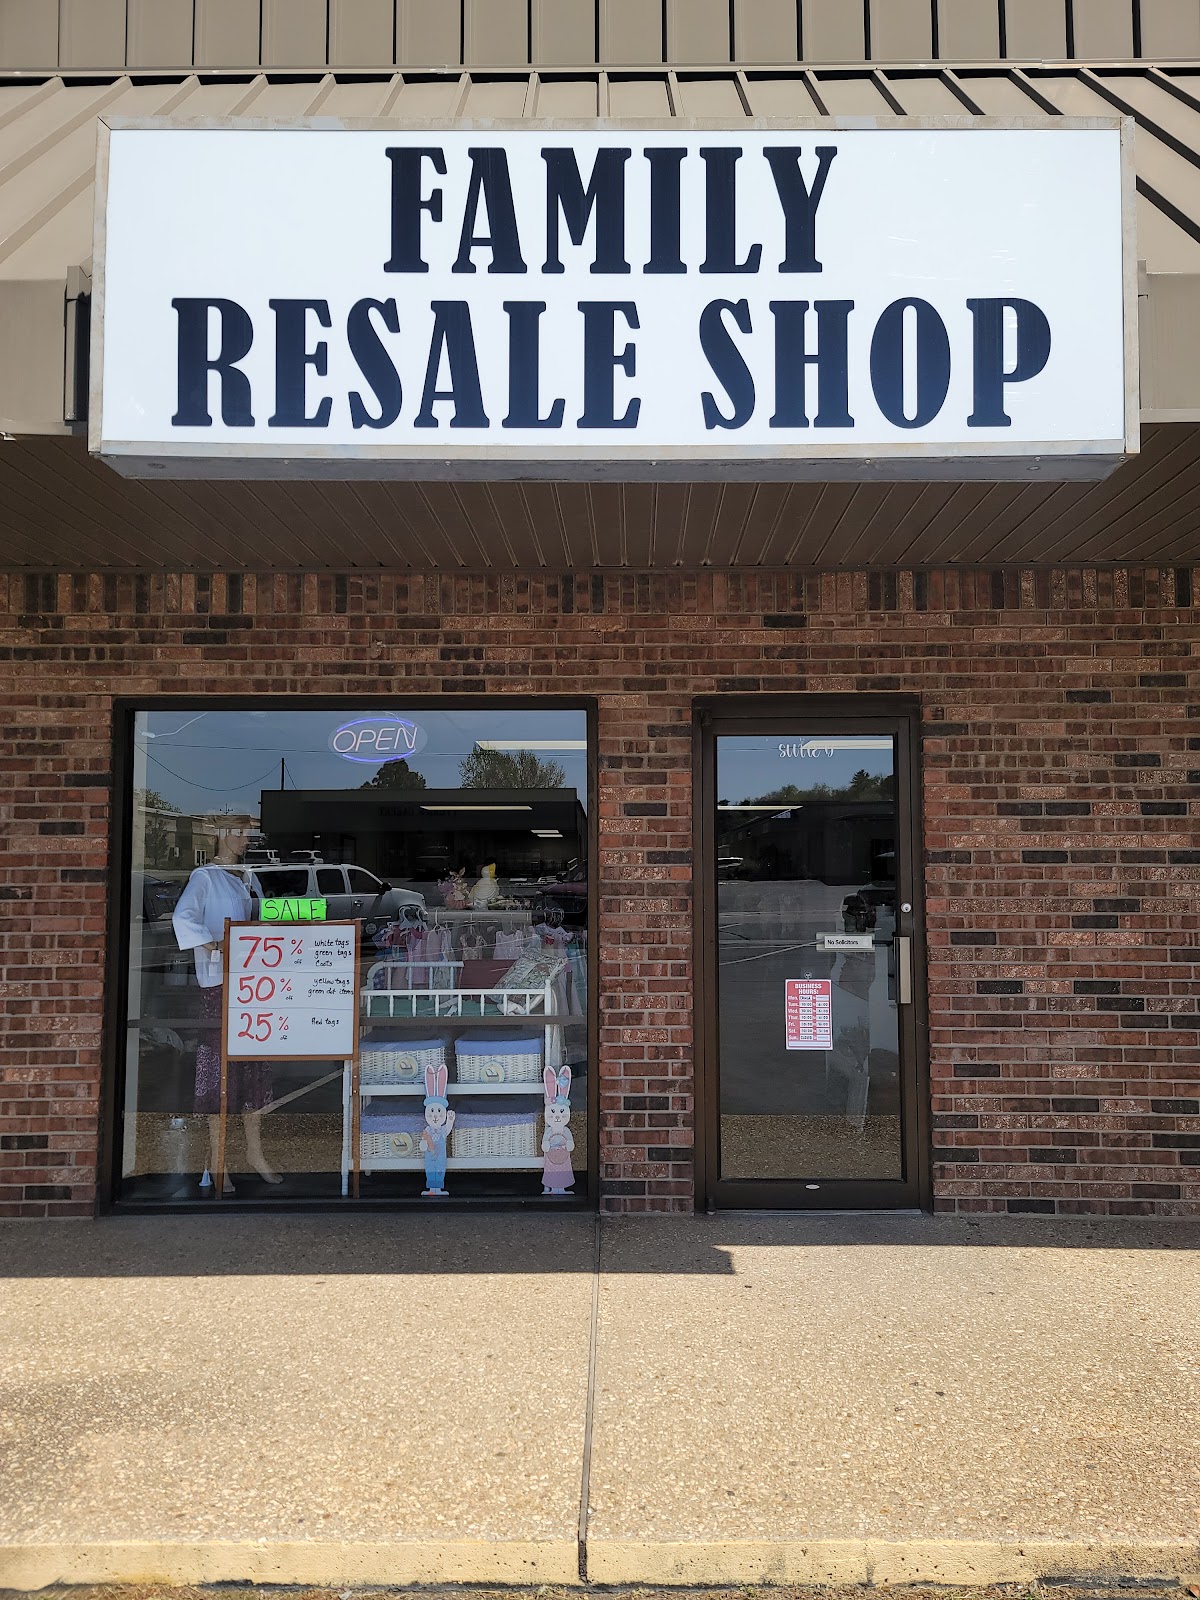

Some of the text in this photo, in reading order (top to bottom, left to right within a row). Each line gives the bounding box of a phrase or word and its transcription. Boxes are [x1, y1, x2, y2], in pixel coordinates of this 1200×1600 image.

[383, 146, 838, 275] FAMILY
[171, 297, 1052, 431] RESALE SHOP
[333, 727, 418, 752] OPEN
[264, 900, 322, 920] SALE
[238, 936, 303, 968] 75%
[314, 949, 352, 959] green tags
[335, 938, 349, 948] tags
[236, 975, 292, 1004] 50%
[308, 989, 325, 997] green
[313, 978, 350, 987] yellow tags
[237, 1012, 289, 1042] 25%
[325, 1018, 340, 1027] tags
